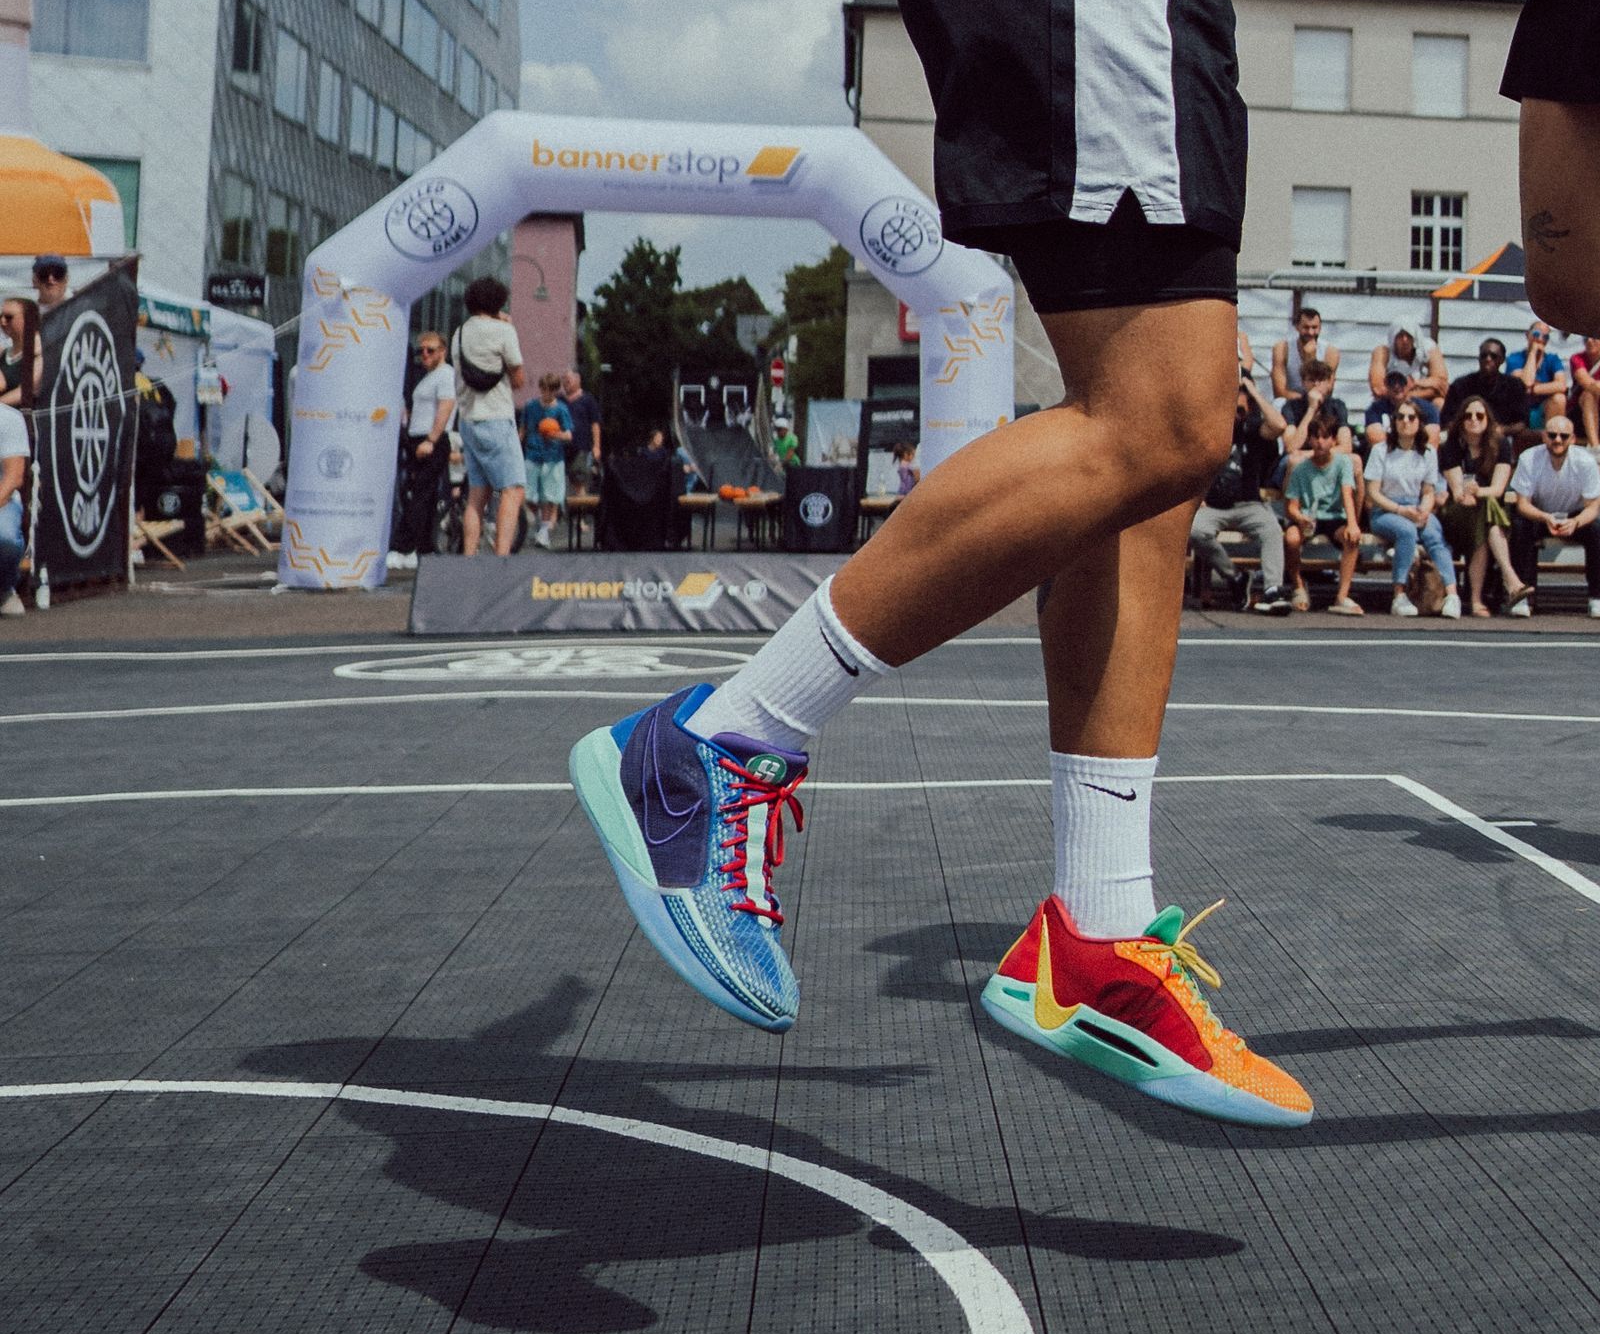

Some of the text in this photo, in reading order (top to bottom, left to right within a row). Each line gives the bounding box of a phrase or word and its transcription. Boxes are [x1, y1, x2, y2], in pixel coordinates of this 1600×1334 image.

[532, 139, 740, 184] bannerstop
[432, 224, 470, 254] GAME
[71, 329, 117, 399] CALLED
[531, 576, 674, 602] bannerstop
